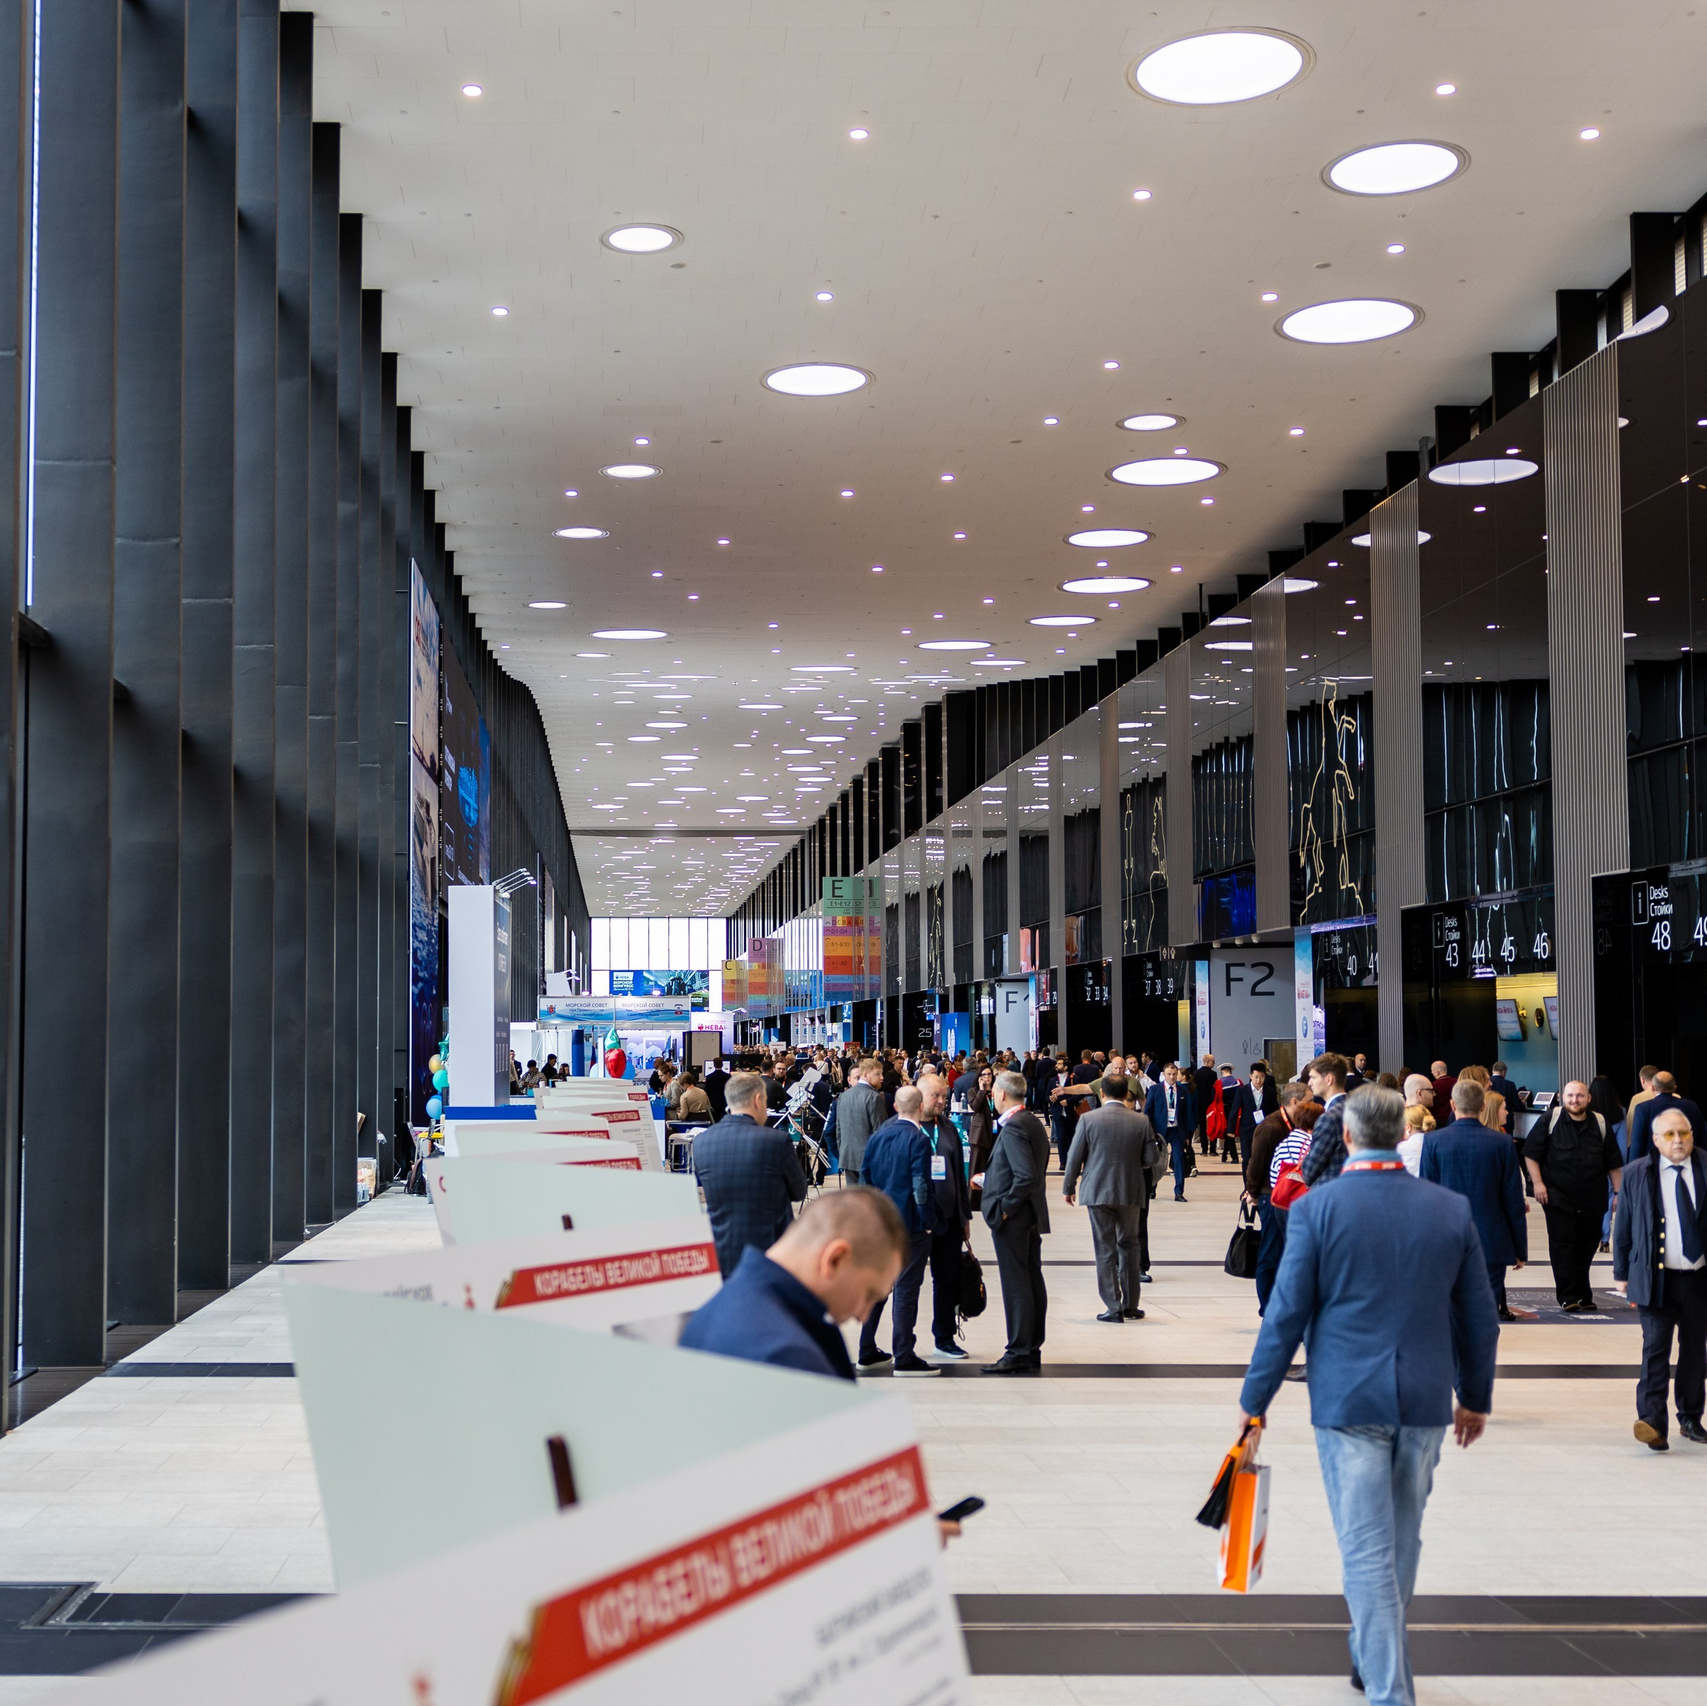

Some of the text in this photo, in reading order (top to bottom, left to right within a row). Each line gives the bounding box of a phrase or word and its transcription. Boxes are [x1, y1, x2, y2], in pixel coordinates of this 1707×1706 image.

[832, 880, 843, 898] E
[1649, 885, 1669, 900] Desks
[1649, 901, 1674, 917] Стойки
[1445, 916, 1458, 928] Desks
[1445, 929, 1461, 942] Стойки
[1651, 920, 1671, 951] 48
[752, 940, 762, 952] D
[1445, 932, 1549, 967] 43 44 45 46
[724, 960, 732, 971] C
[1347, 952, 1379, 976] 40 41
[1225, 962, 1275, 997] F2
[918, 1027, 933, 1038] 25
[533, 1248, 710, 1297] КОРАБЕЛЫ ВЕЛИКОЙ ПОБЕДЫ
[580, 1541, 731, 1660] КОРАБЕЛЫ
[730, 1489, 834, 1588] ВЕЛИКОЙ
[833, 1460, 916, 1531] ПОБЕДЫ
